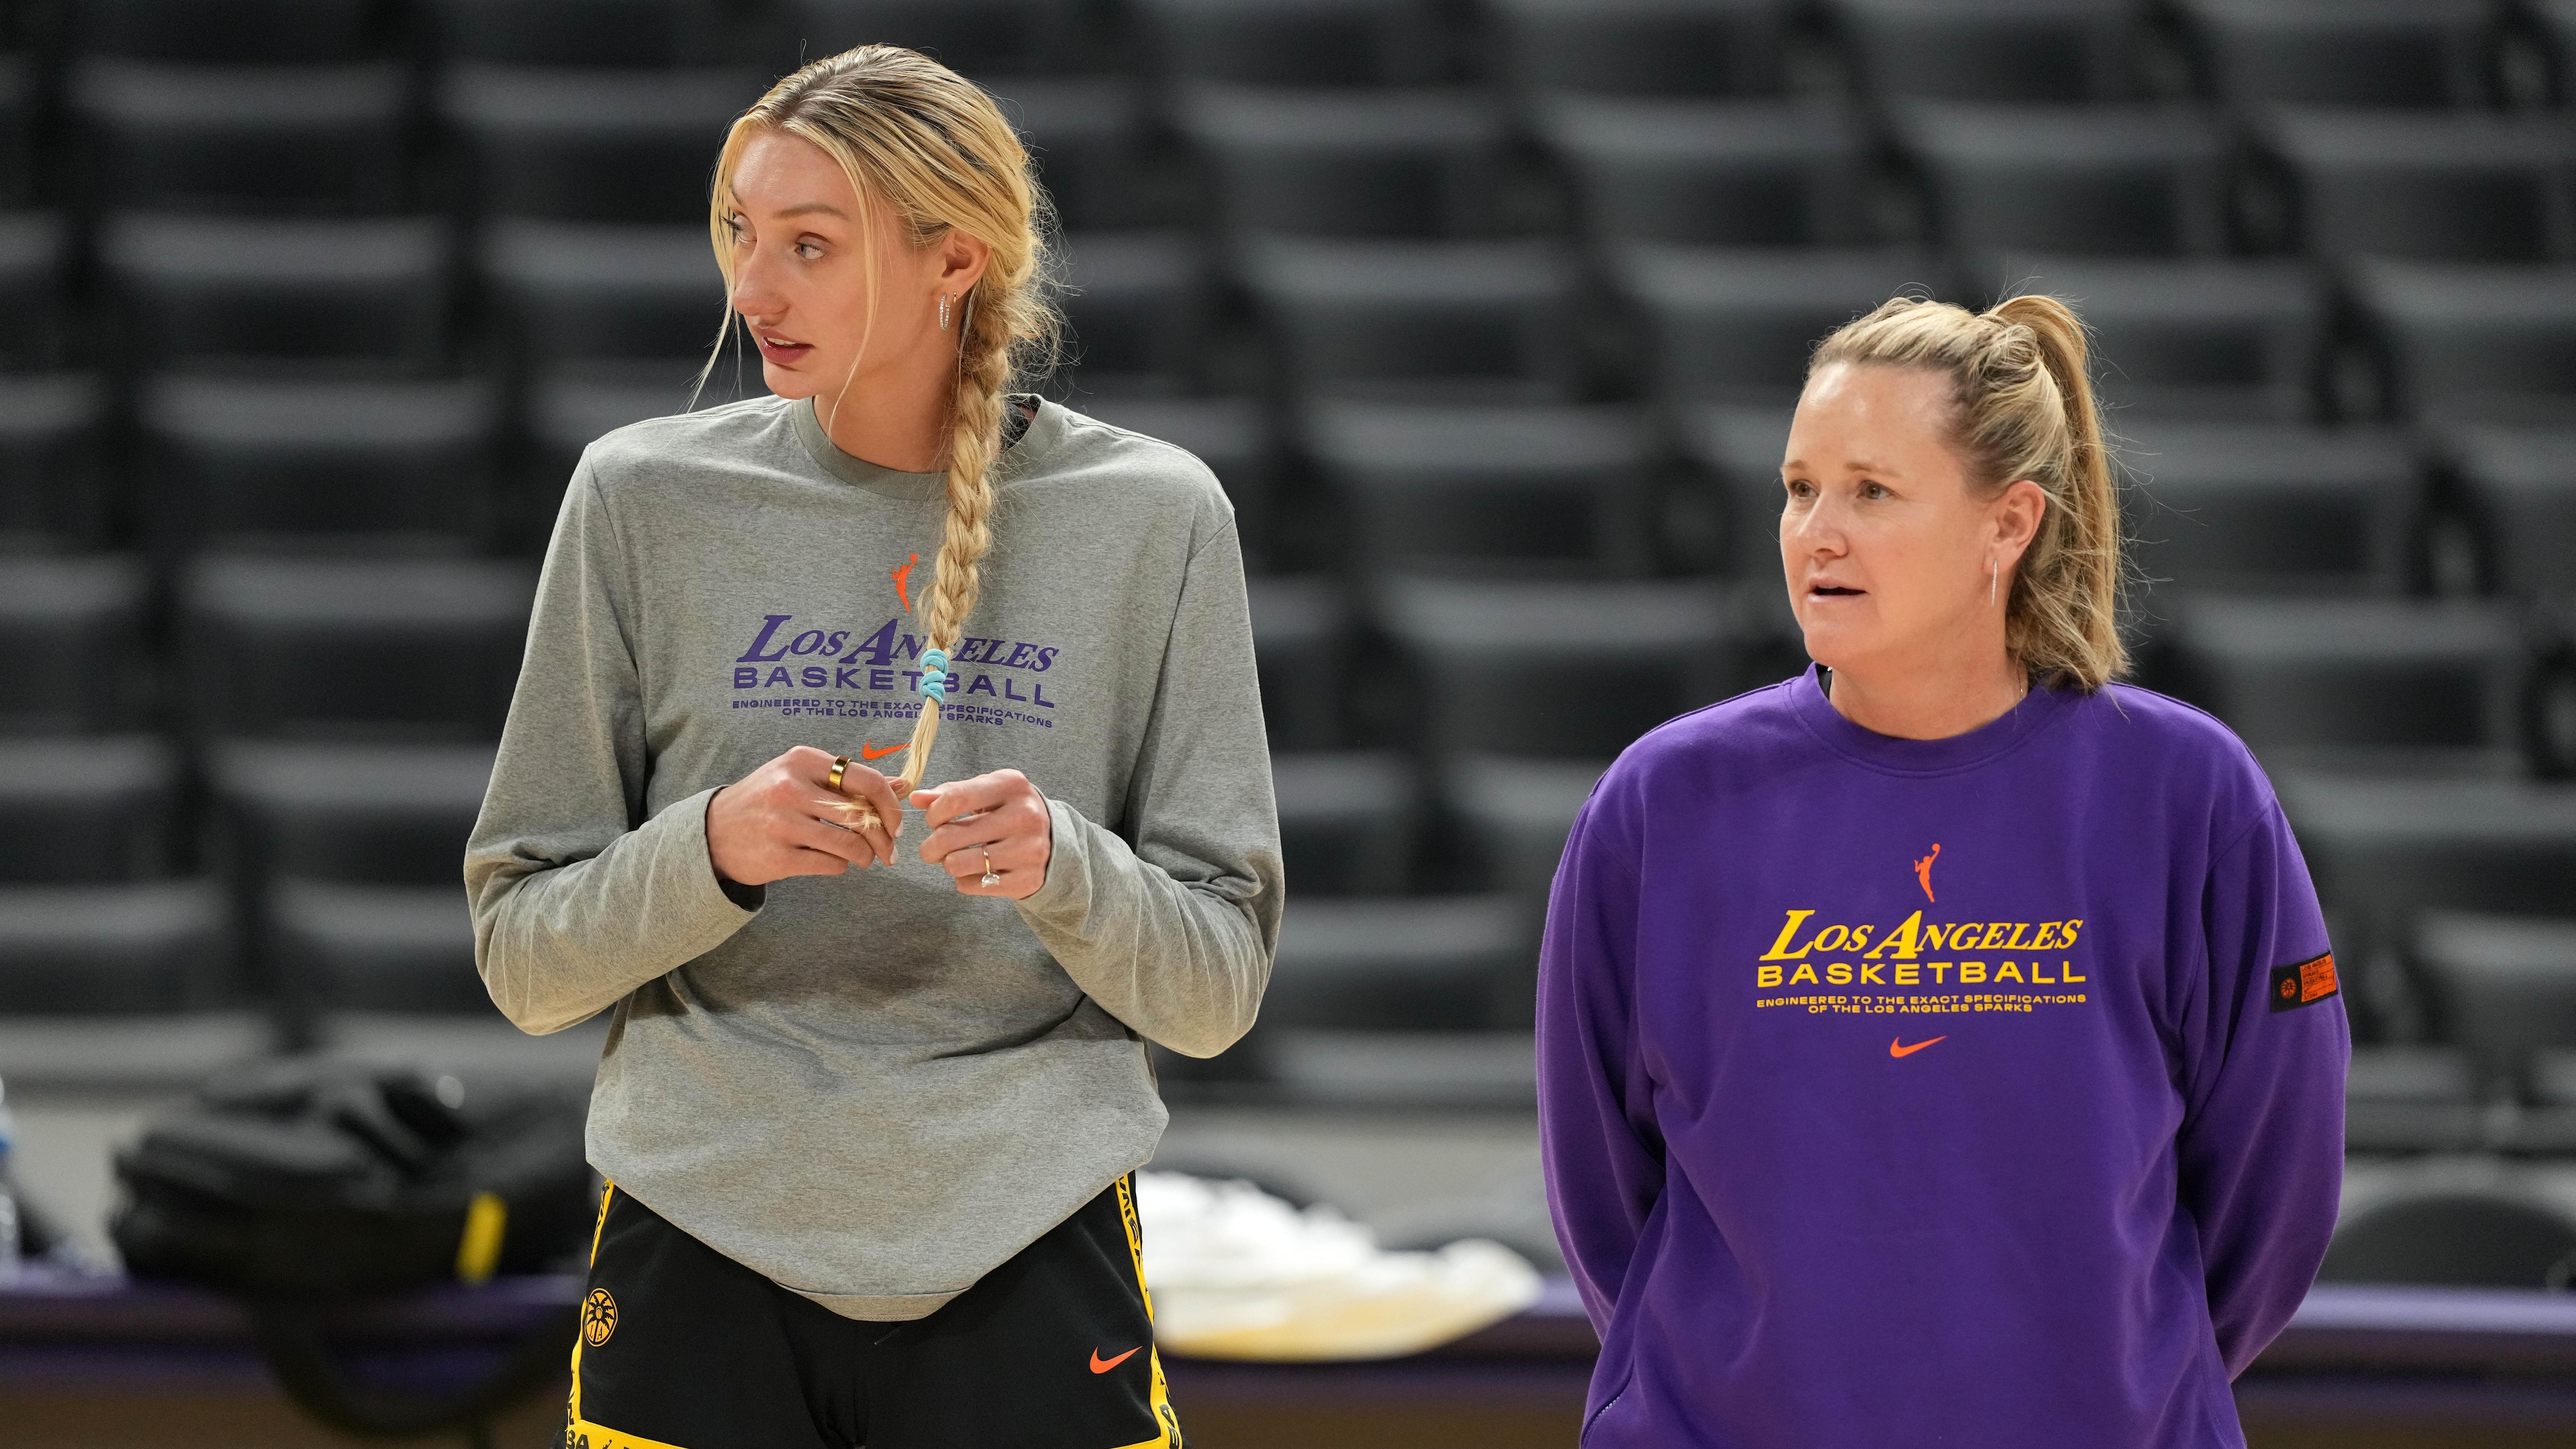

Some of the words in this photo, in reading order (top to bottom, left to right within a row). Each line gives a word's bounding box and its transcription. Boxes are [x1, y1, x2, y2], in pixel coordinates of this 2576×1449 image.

[840, 618, 1059, 672] ANELES
[734, 666, 1055, 708] BASKETBALL
[733, 699, 821, 708] ENGINEERED
[884, 702, 924, 710] EXAC
[939, 704, 1052, 728] SPECIFICATIONS
[806, 708, 834, 716] THE
[839, 708, 868, 718] LOS
[873, 711, 941, 719] ANGE
[947, 713, 1003, 726] SPARKS
[1757, 960, 2086, 988] BASKETBALL
[1756, 996, 1848, 1008] ENGINEERED
[1852, 996, 1872, 1004] TO
[1876, 996, 1905, 1004] THE
[1909, 995, 1959, 1004] EXACT
[1964, 994, 2087, 1004] SPECIFICATIONS
[1808, 1005, 1827, 1014] OF
[1832, 1005, 1861, 1013] THE
[1865, 1005, 1895, 1013] LOS
[1899, 1004, 1970, 1013] ANGELES
[1974, 1003, 2032, 1013] SPARKS
